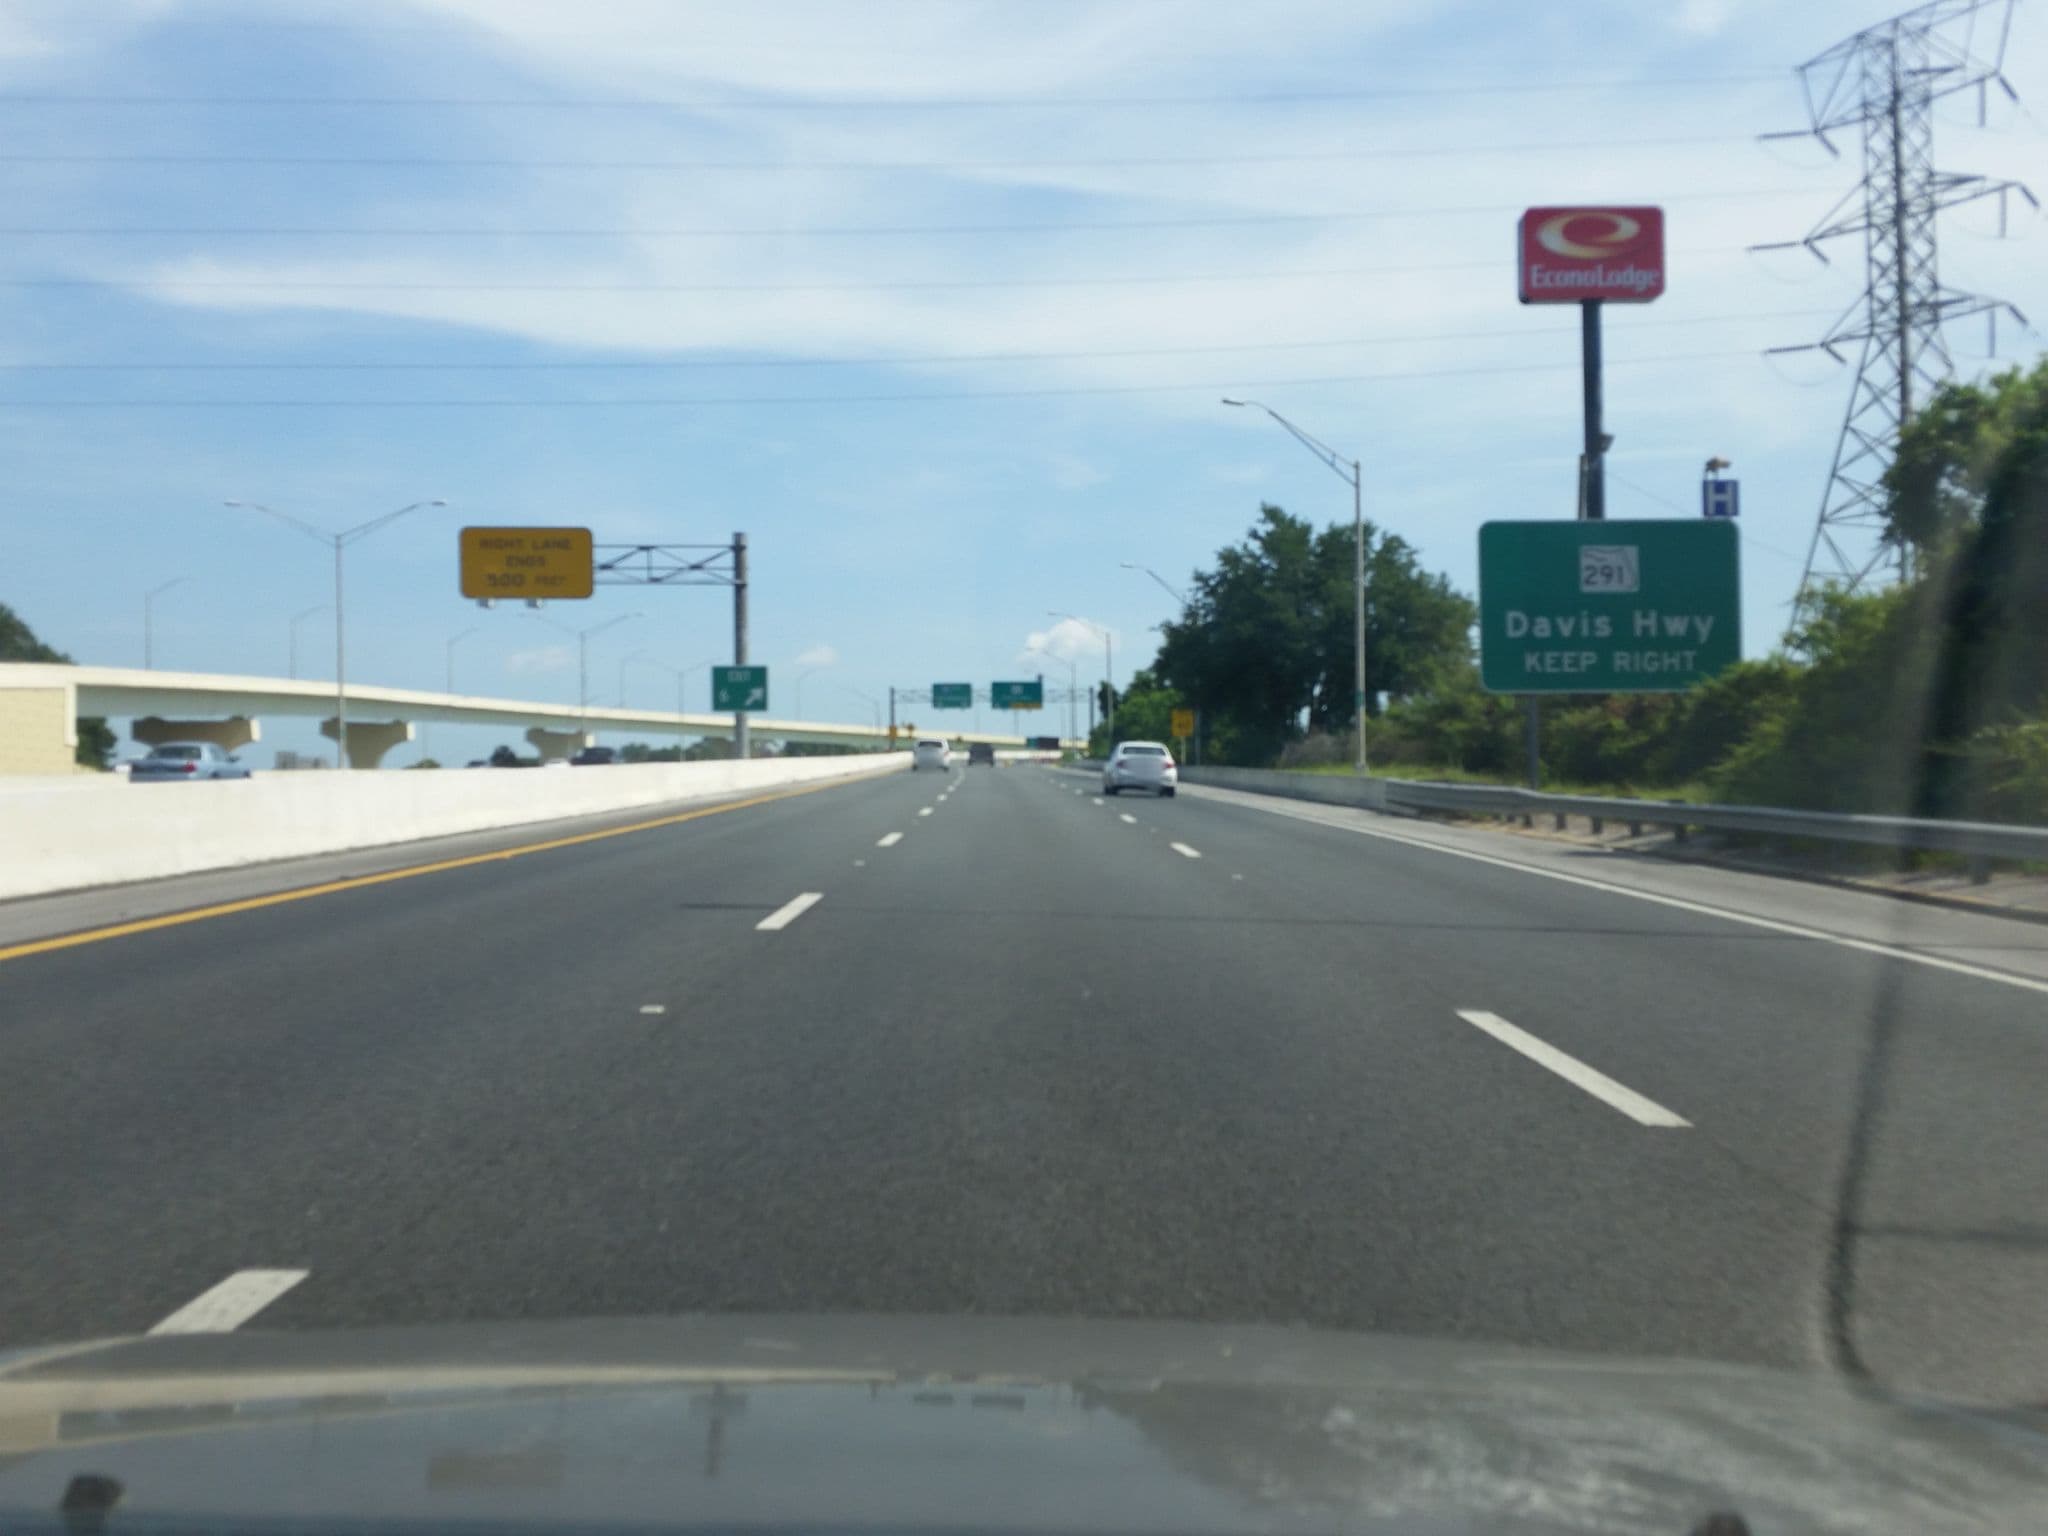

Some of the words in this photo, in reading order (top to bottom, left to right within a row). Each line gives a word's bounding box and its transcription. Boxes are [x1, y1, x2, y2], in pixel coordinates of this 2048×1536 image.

[1530, 265, 1659, 292] EconoLodge
[1707, 482, 1736, 514] H
[480, 538, 522, 549] RIGHT
[531, 538, 571, 550] LANE
[1583, 565, 1625, 585] 291
[1505, 609, 1612, 638] Davis
[1633, 609, 1714, 644] Hwy
[1524, 651, 1597, 673] KEEP
[1613, 651, 1697, 673] RIGHT
